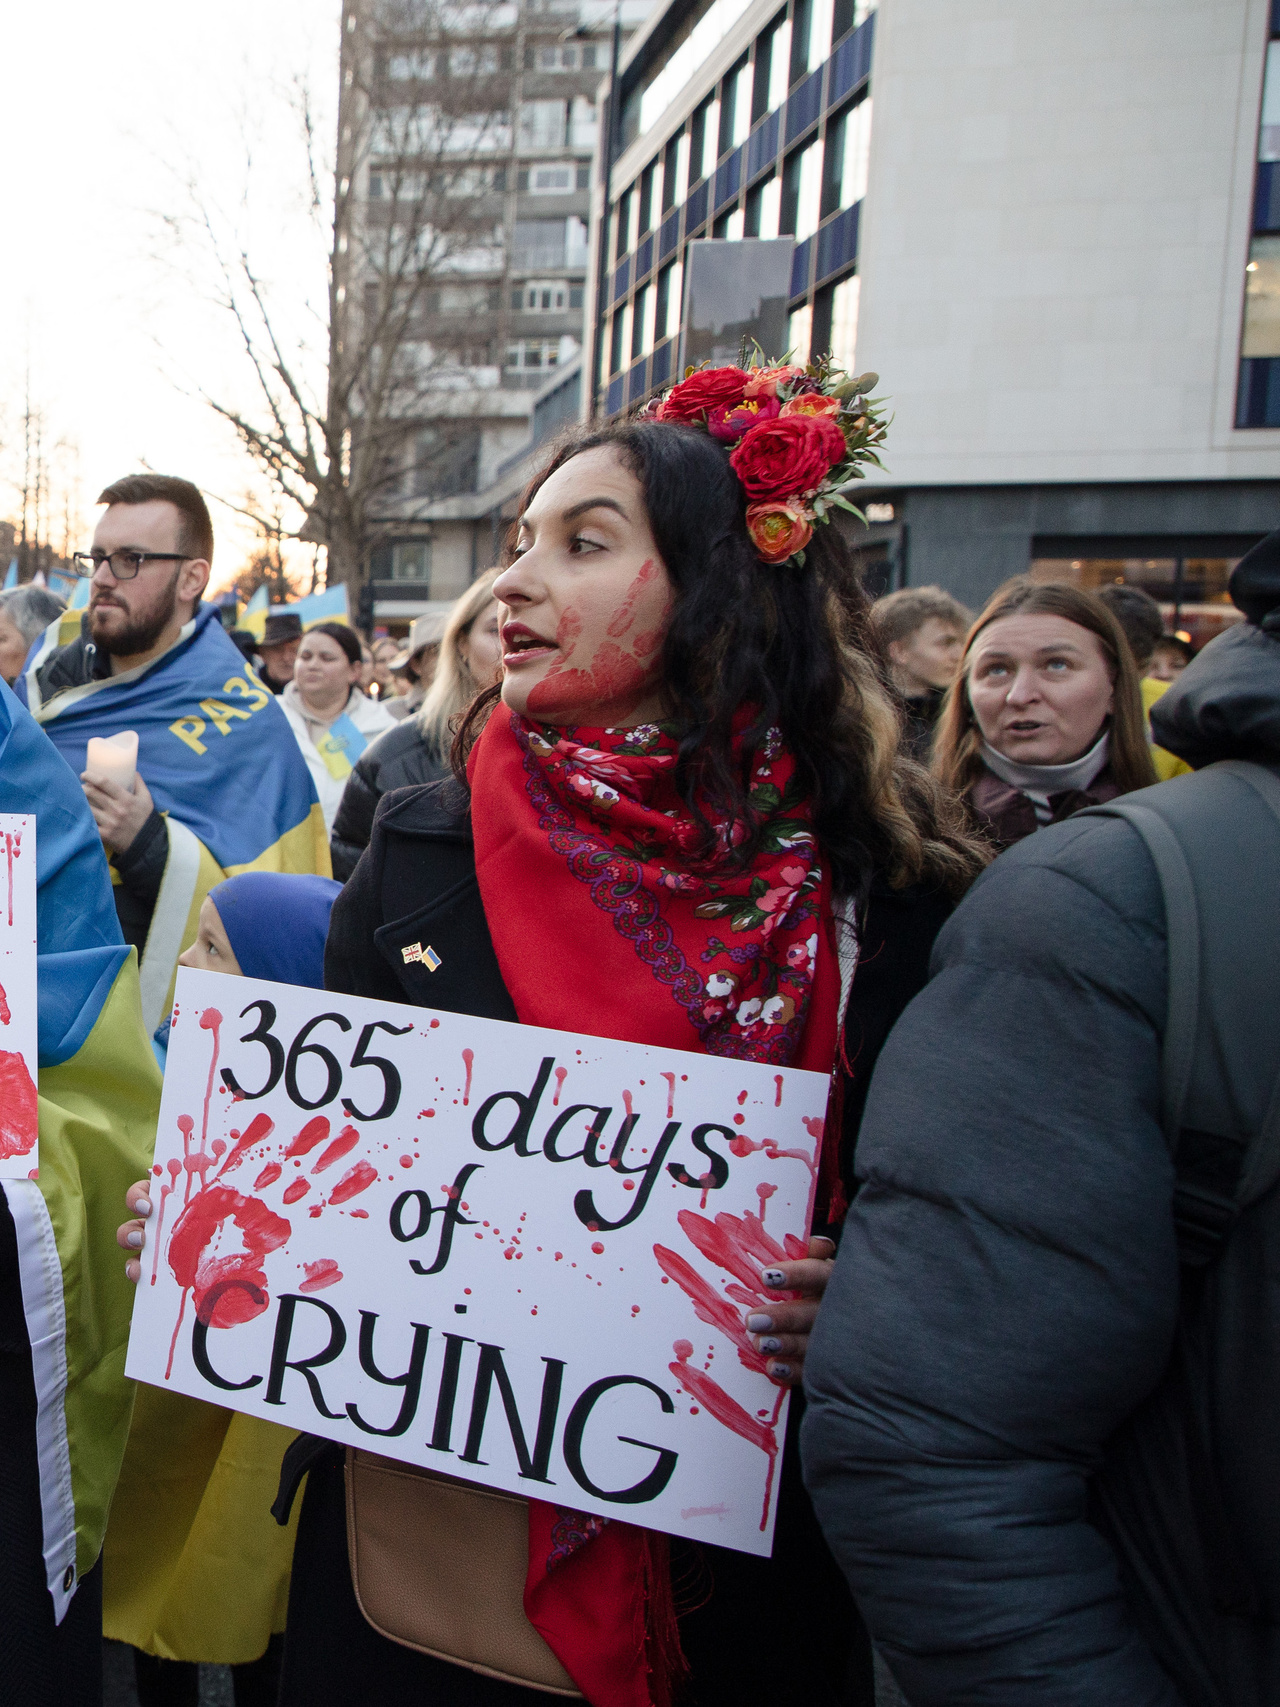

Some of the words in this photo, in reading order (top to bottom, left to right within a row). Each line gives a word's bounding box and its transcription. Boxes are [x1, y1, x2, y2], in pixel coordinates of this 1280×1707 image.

[220, 1000, 415, 1122] 365
[471, 1056, 737, 1232] days
[389, 1163, 485, 1275] of
